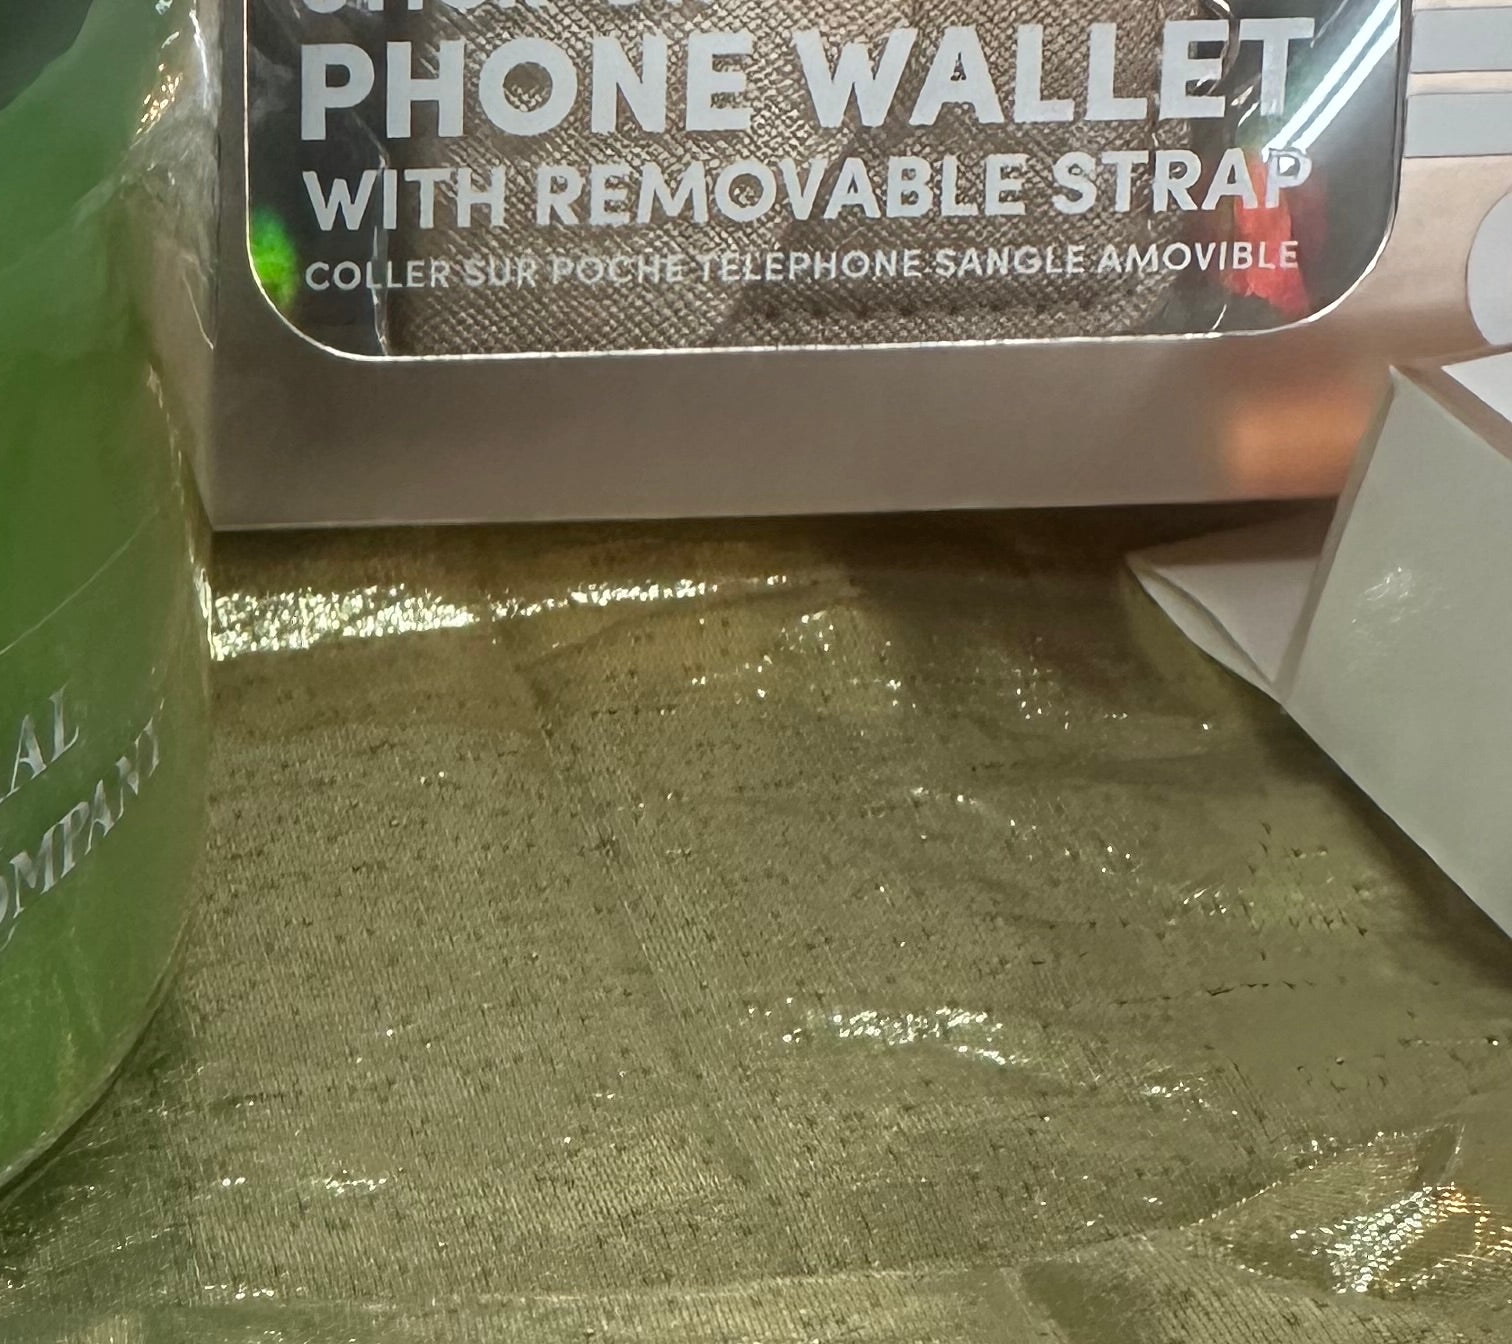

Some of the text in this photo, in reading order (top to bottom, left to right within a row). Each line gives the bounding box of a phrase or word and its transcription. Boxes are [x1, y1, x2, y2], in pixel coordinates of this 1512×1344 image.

[300, 16, 1316, 141] PHONE WALLET
[301, 146, 1313, 232] WITH REMOVABLE STRAP
[304, 239, 1299, 291] COLLER SUR POCHE TELEPHONE SANGLE AMOVIBLE
